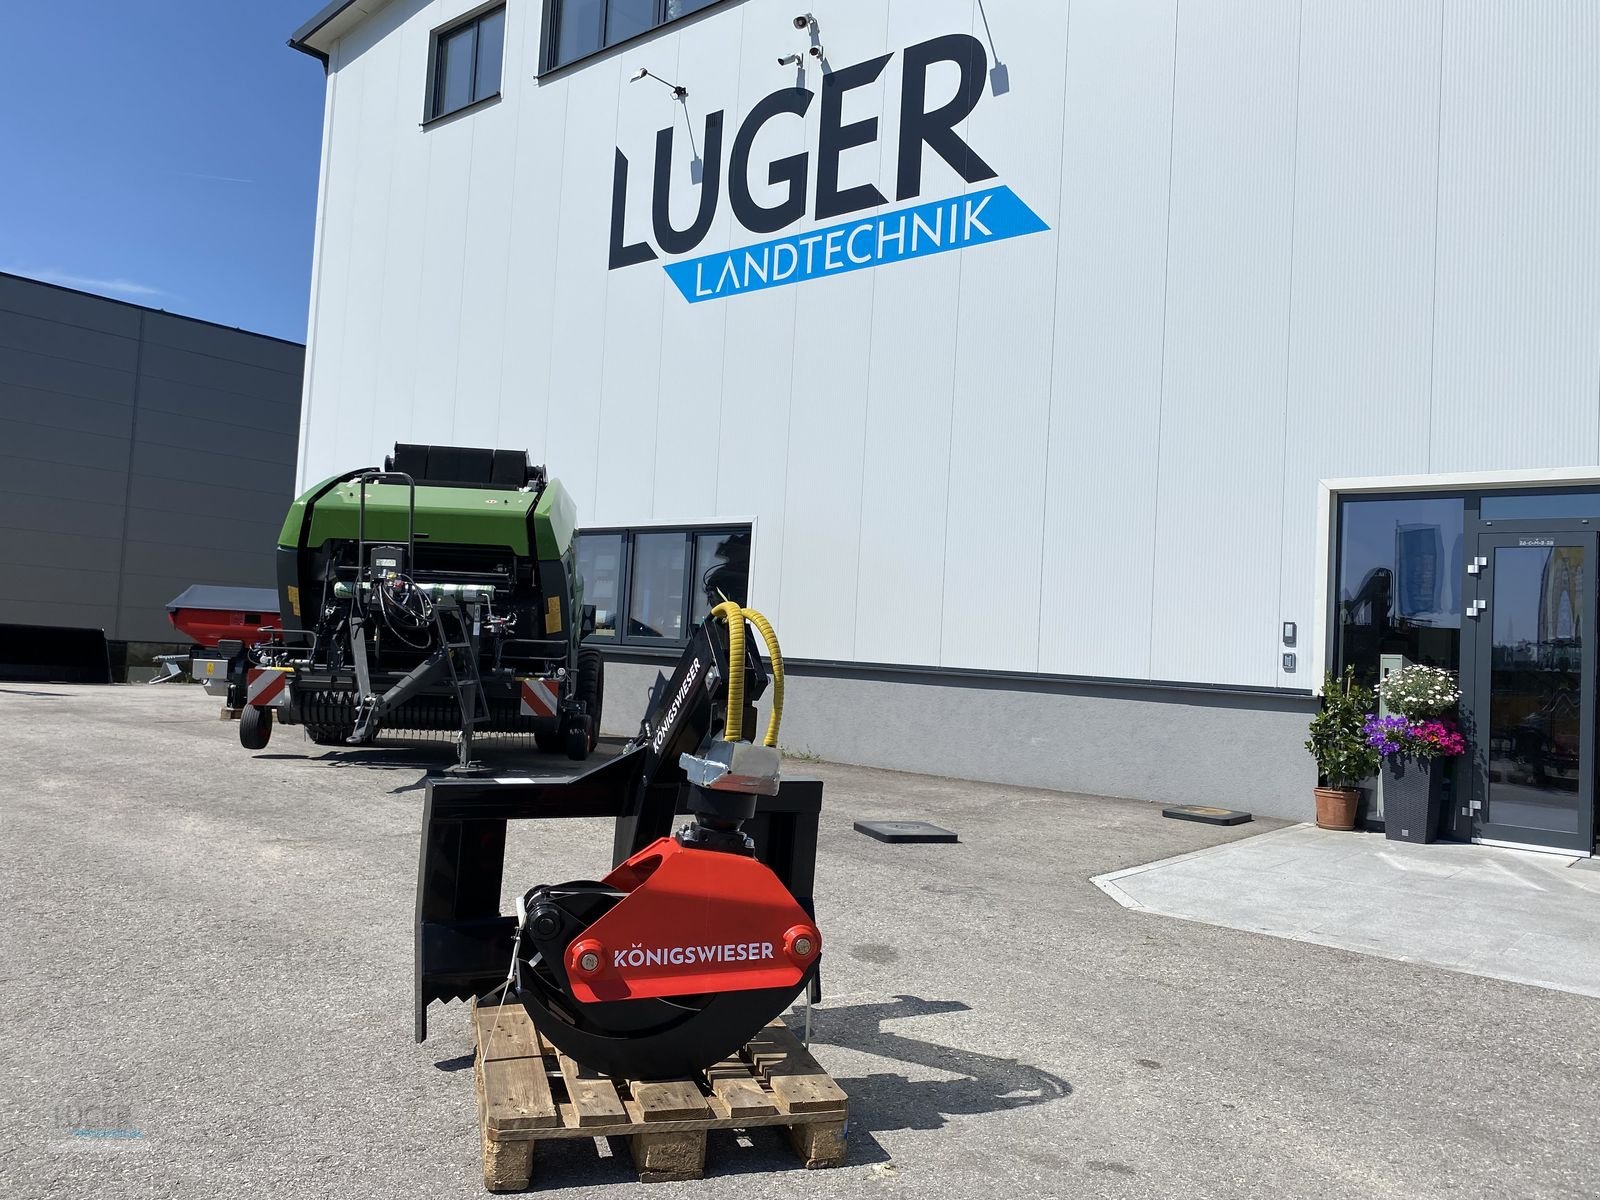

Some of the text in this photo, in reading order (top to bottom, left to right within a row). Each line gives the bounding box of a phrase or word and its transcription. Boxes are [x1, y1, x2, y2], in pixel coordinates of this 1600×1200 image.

[608, 34, 998, 270] LUGER
[695, 195, 993, 297] LANDTECHNIK
[653, 657, 701, 754] KÖNIGSWIESER
[614, 942, 774, 967] KÖNIGSWIESER
